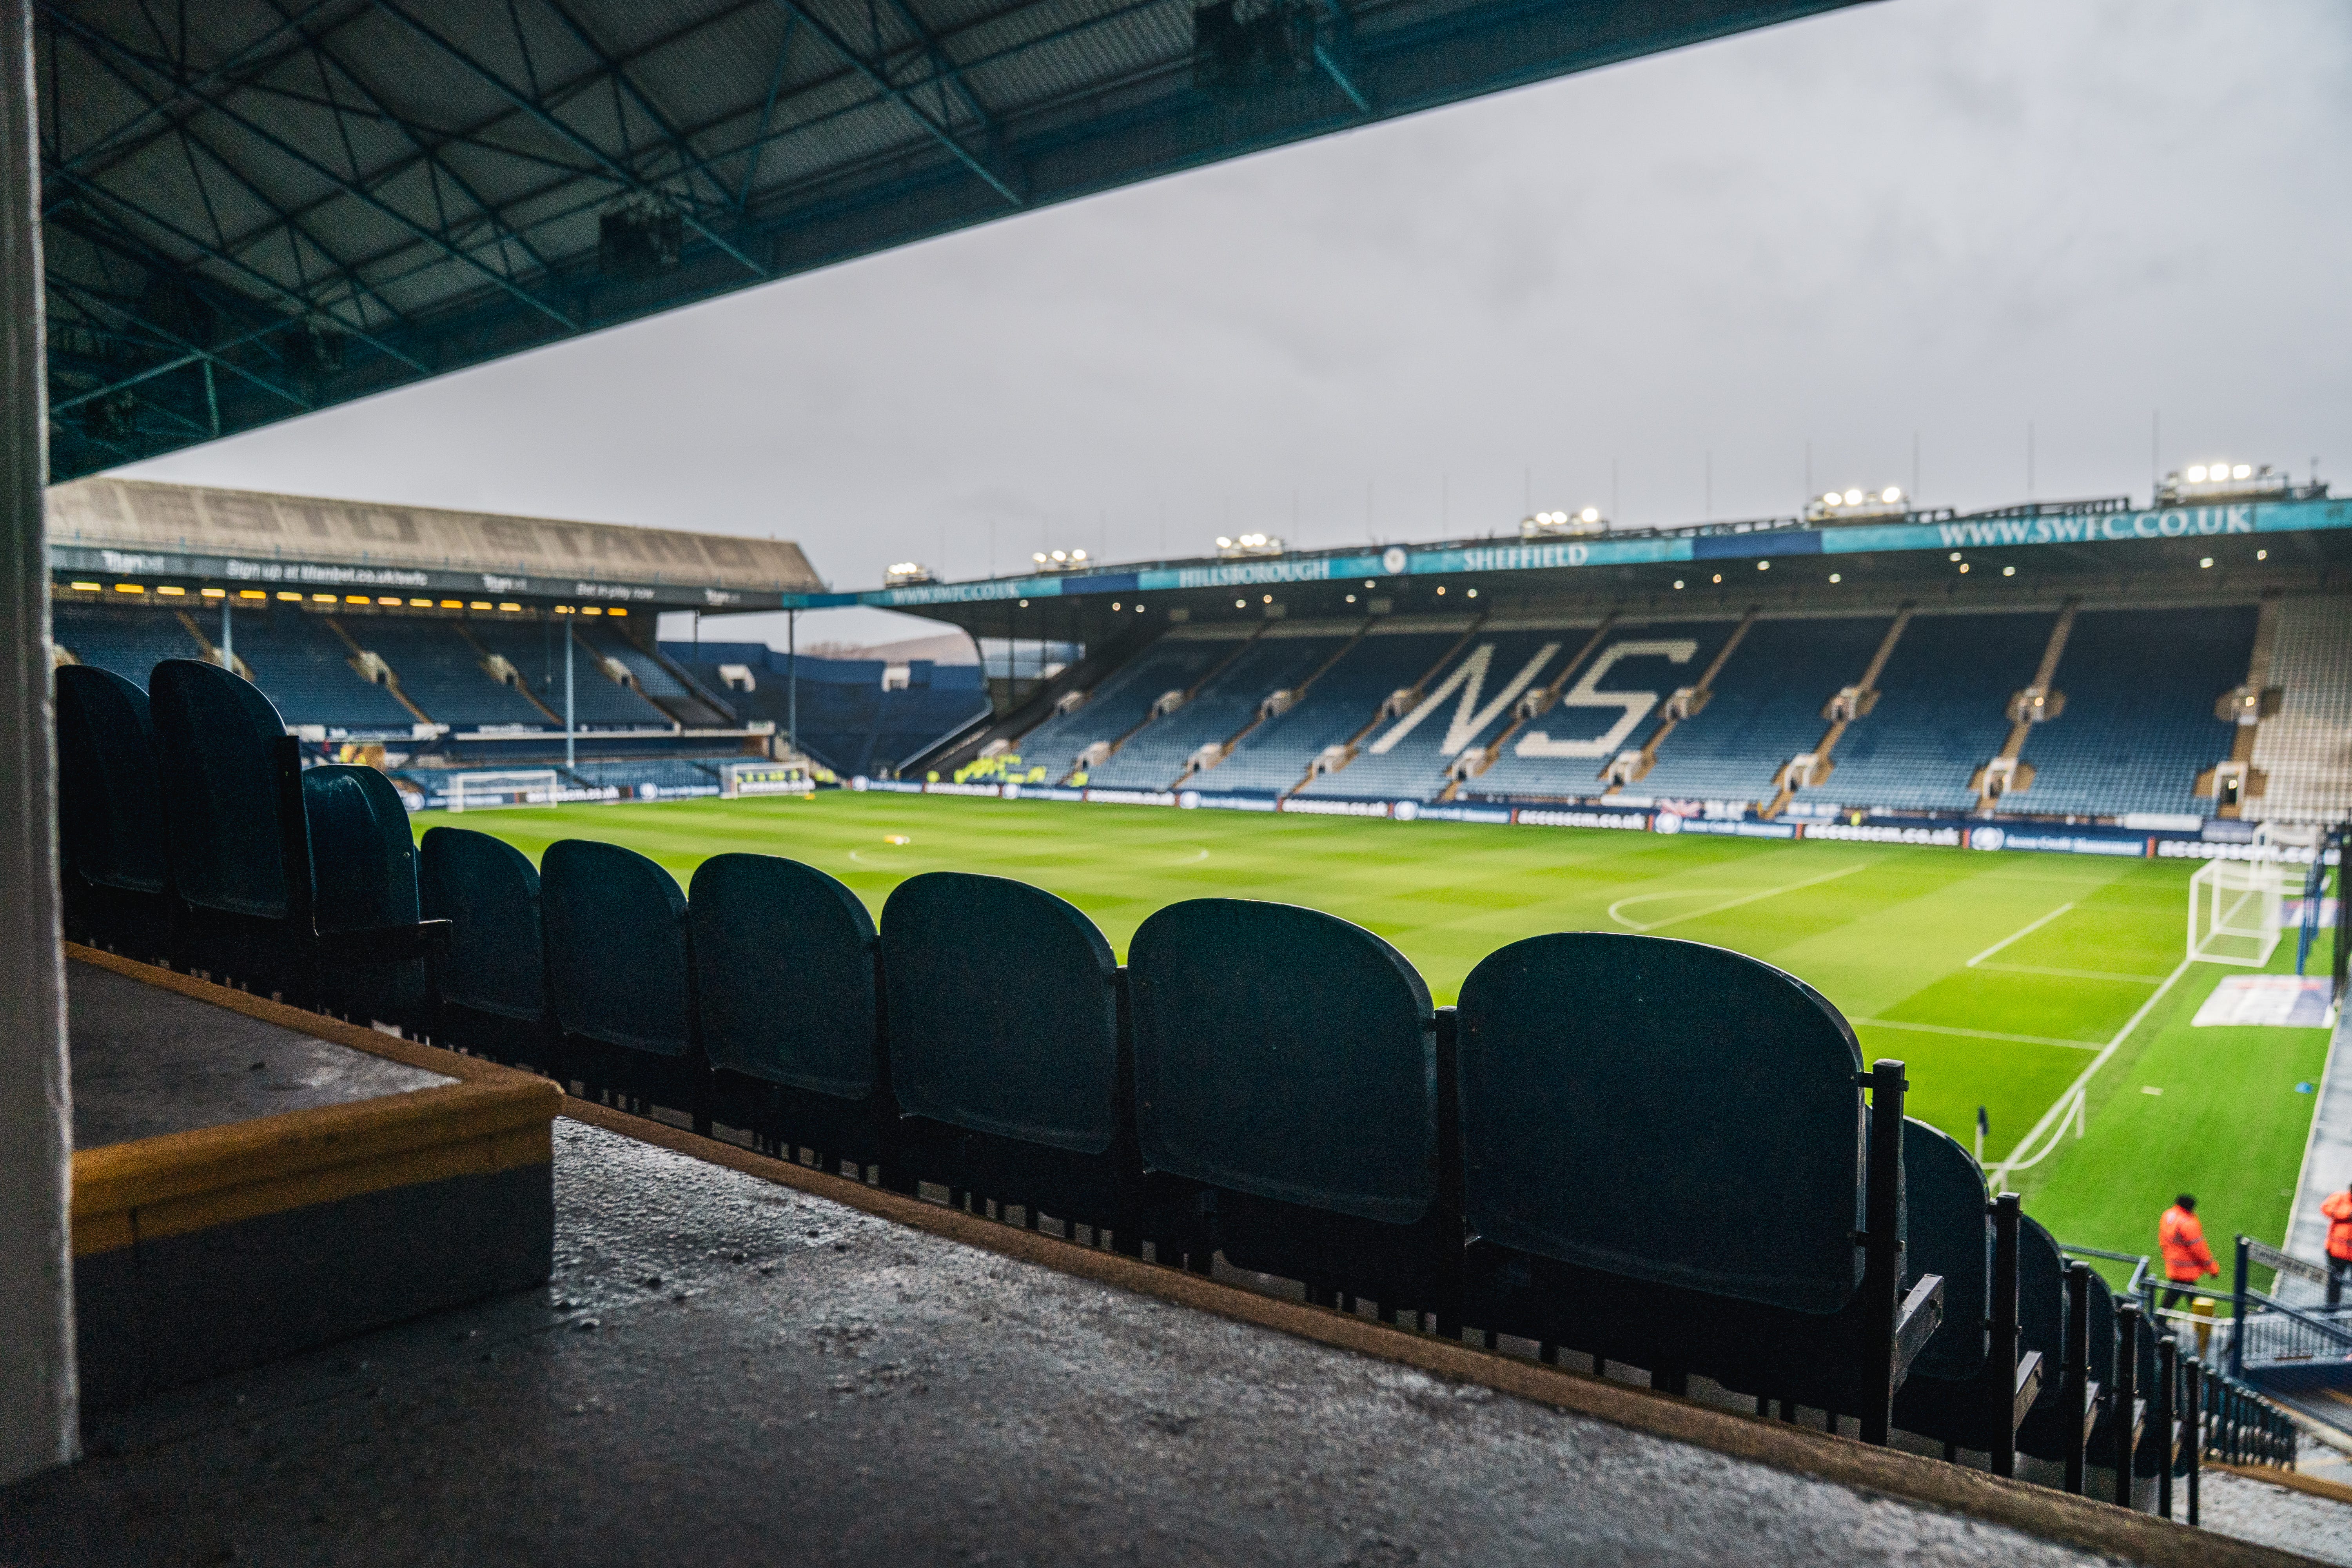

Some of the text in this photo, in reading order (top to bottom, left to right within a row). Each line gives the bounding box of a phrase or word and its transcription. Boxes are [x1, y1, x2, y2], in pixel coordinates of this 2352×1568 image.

[1939, 505, 2252, 548] WWW.SWFC.CO.UK
[226, 559, 260, 580] Sign
[263, 564, 283, 581] up
[285, 565, 299, 579] at
[1463, 543, 1588, 572] SHEFFIELD
[1179, 561, 1330, 588] HILLSBOROUGH
[633, 588, 655, 600] now
